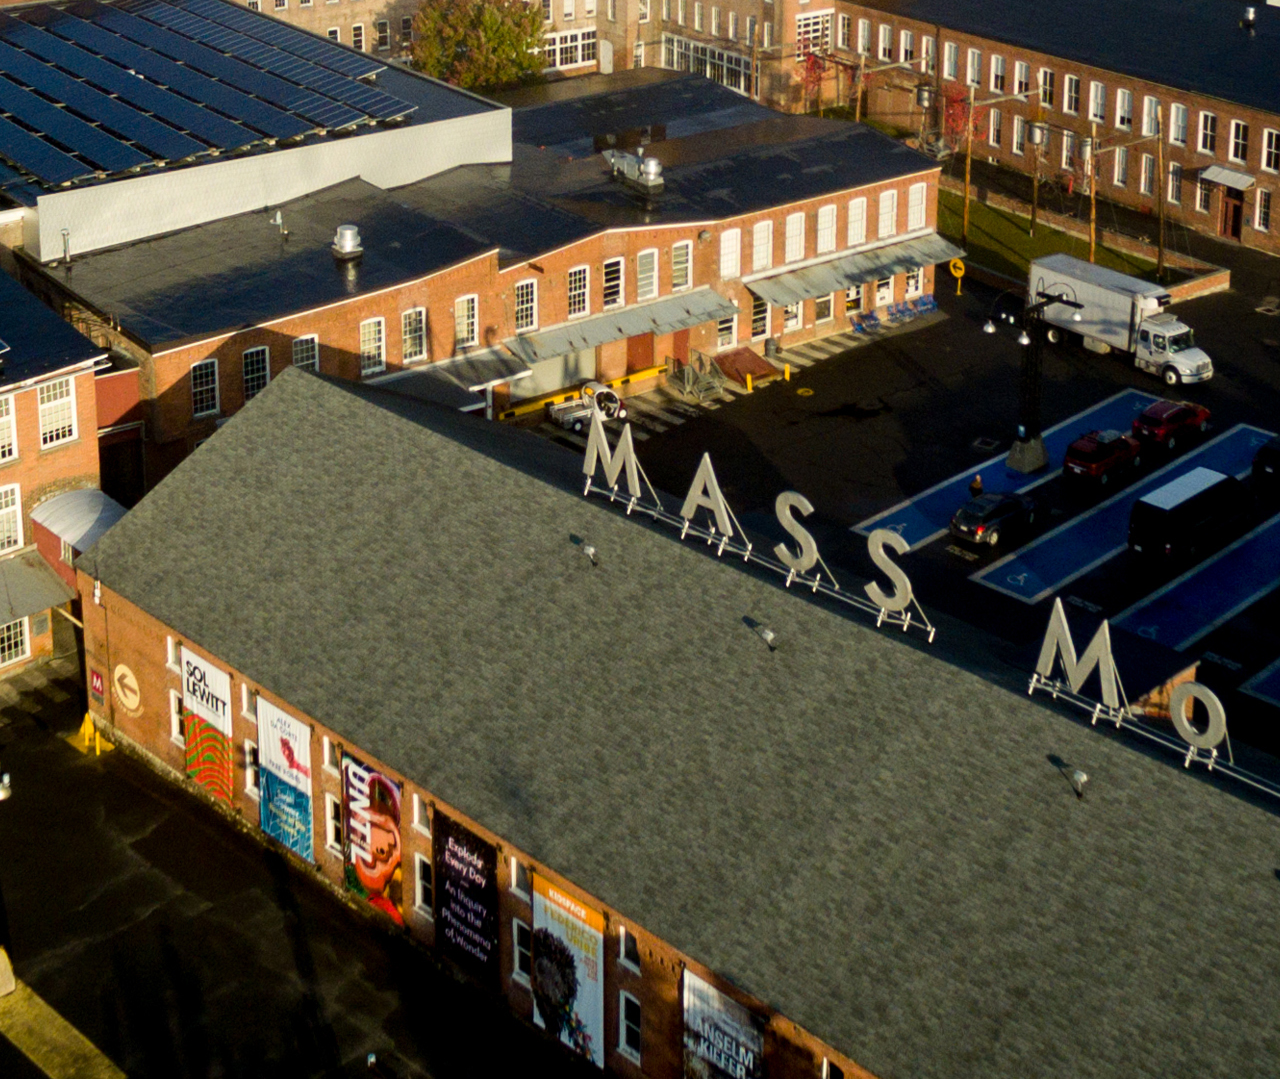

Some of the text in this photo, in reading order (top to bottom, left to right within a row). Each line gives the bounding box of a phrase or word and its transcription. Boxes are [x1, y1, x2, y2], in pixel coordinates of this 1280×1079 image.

[583, 411, 913, 613] MASS
[186, 661, 209, 688] SOL
[187, 677, 227, 717] LEWITT
[348, 762, 373, 865] UNTIL
[445, 850, 487, 889] Every Day
[448, 836, 483, 869] Explode
[445, 880, 487, 918] An Inquiry
[450, 899, 482, 929] into the
[548, 888, 586, 920] KIDSPACE
[442, 907, 491, 951] Phenomena
[544, 904, 598, 945] FEDERICO
[445, 927, 488, 962] of Wonder
[566, 931, 597, 958] URIBE
[696, 1020, 754, 1071] ANSELM
[700, 1036, 746, 1079] KIEFER
